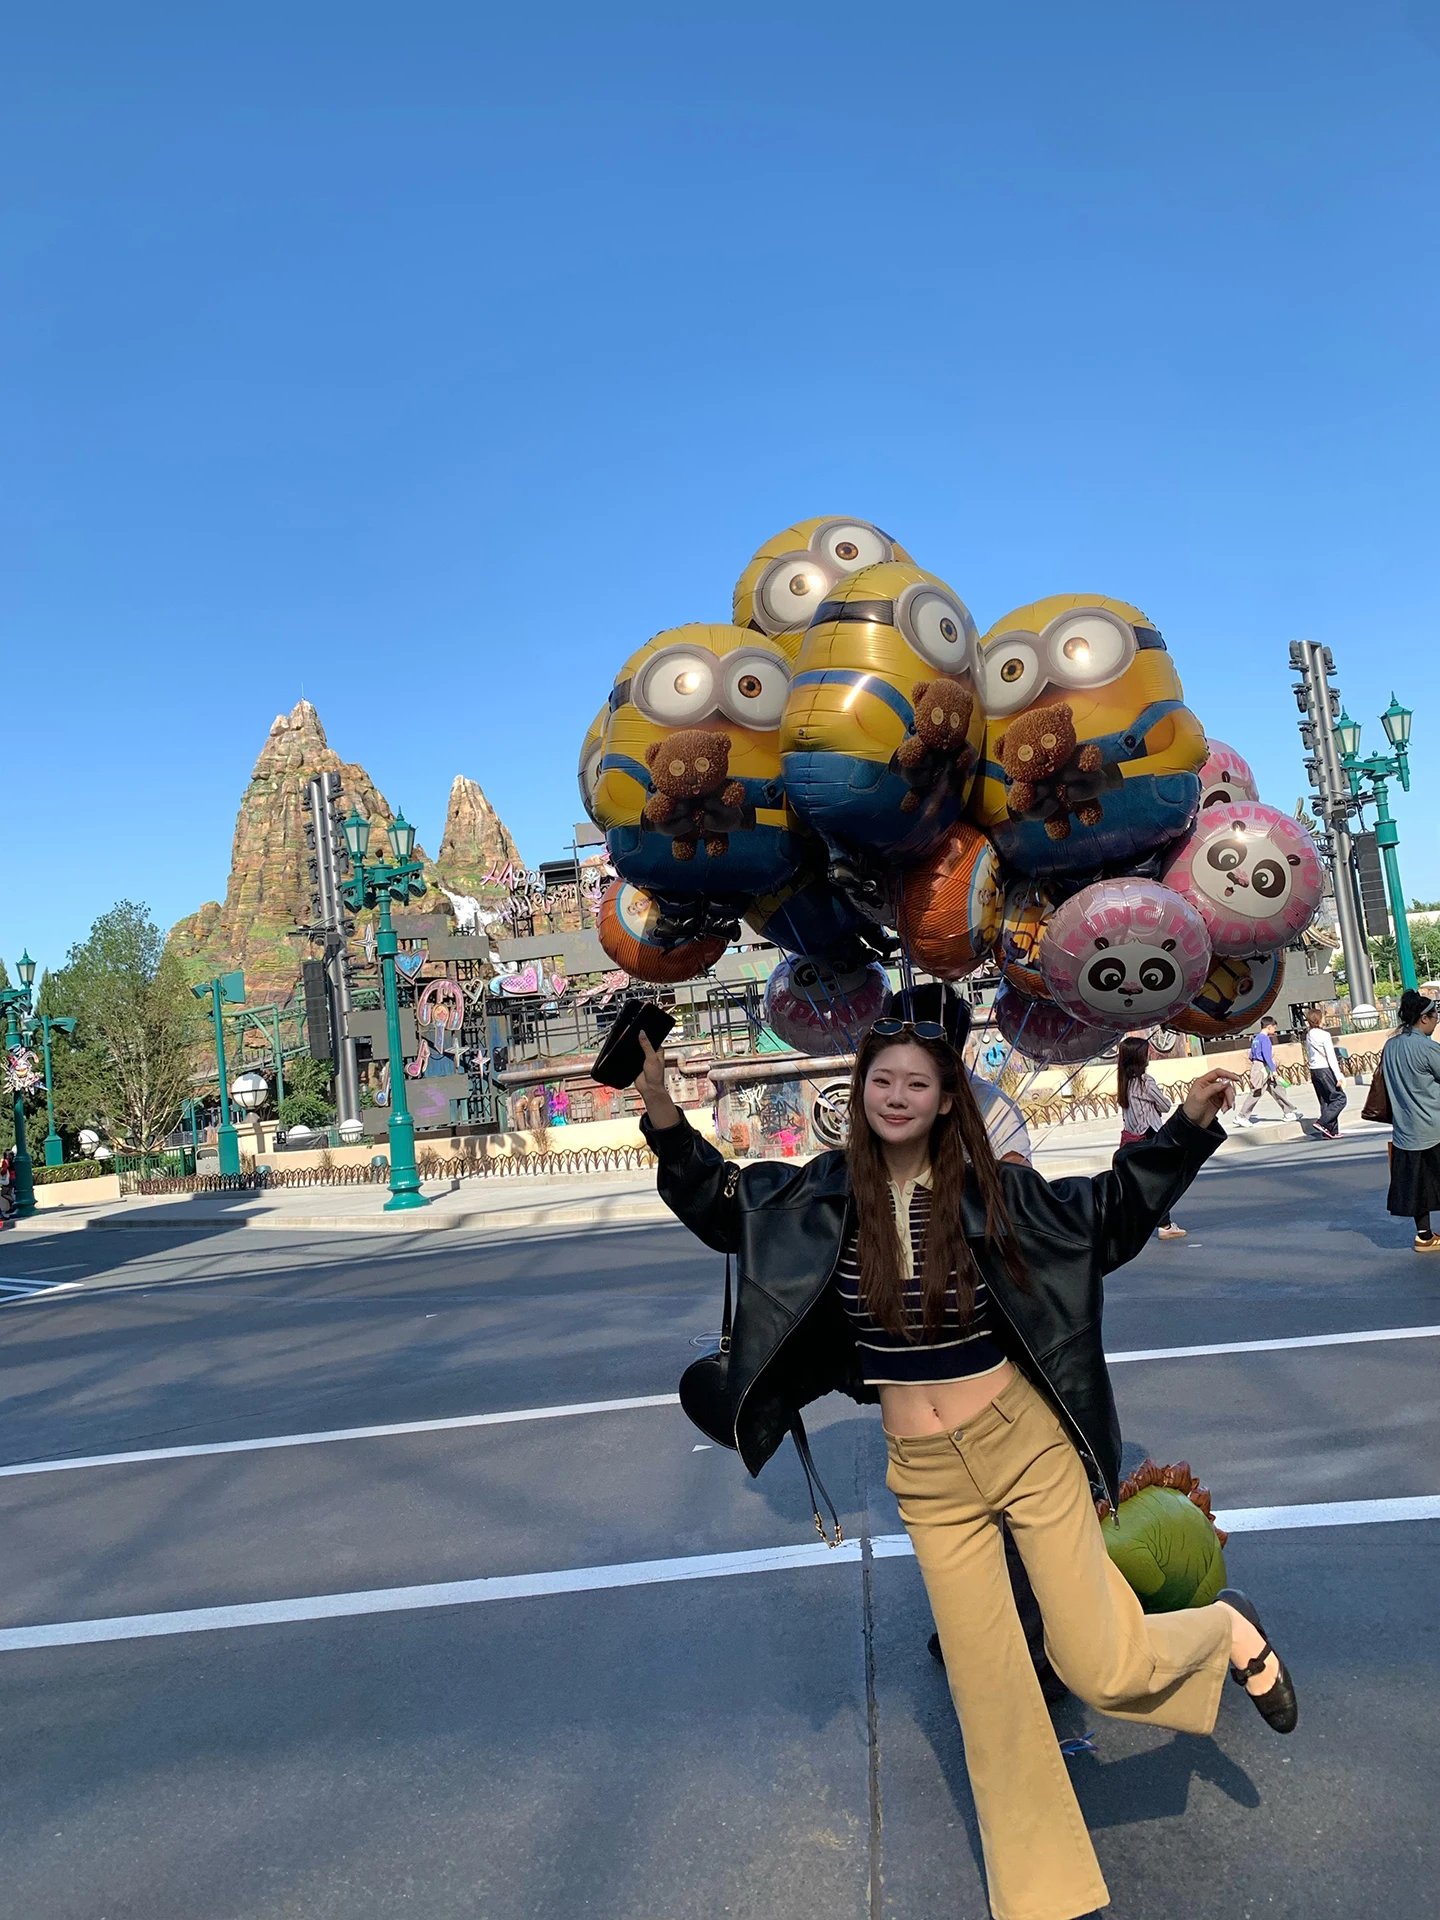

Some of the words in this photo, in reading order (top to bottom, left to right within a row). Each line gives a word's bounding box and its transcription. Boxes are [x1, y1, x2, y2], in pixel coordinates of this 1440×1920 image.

[1201, 752, 1249, 779] KUN
[1201, 806, 1300, 839] KUNG
[1300, 846, 1319, 889] FU
[1061, 905, 1164, 958] KUNG
[1167, 915, 1201, 956] FU
